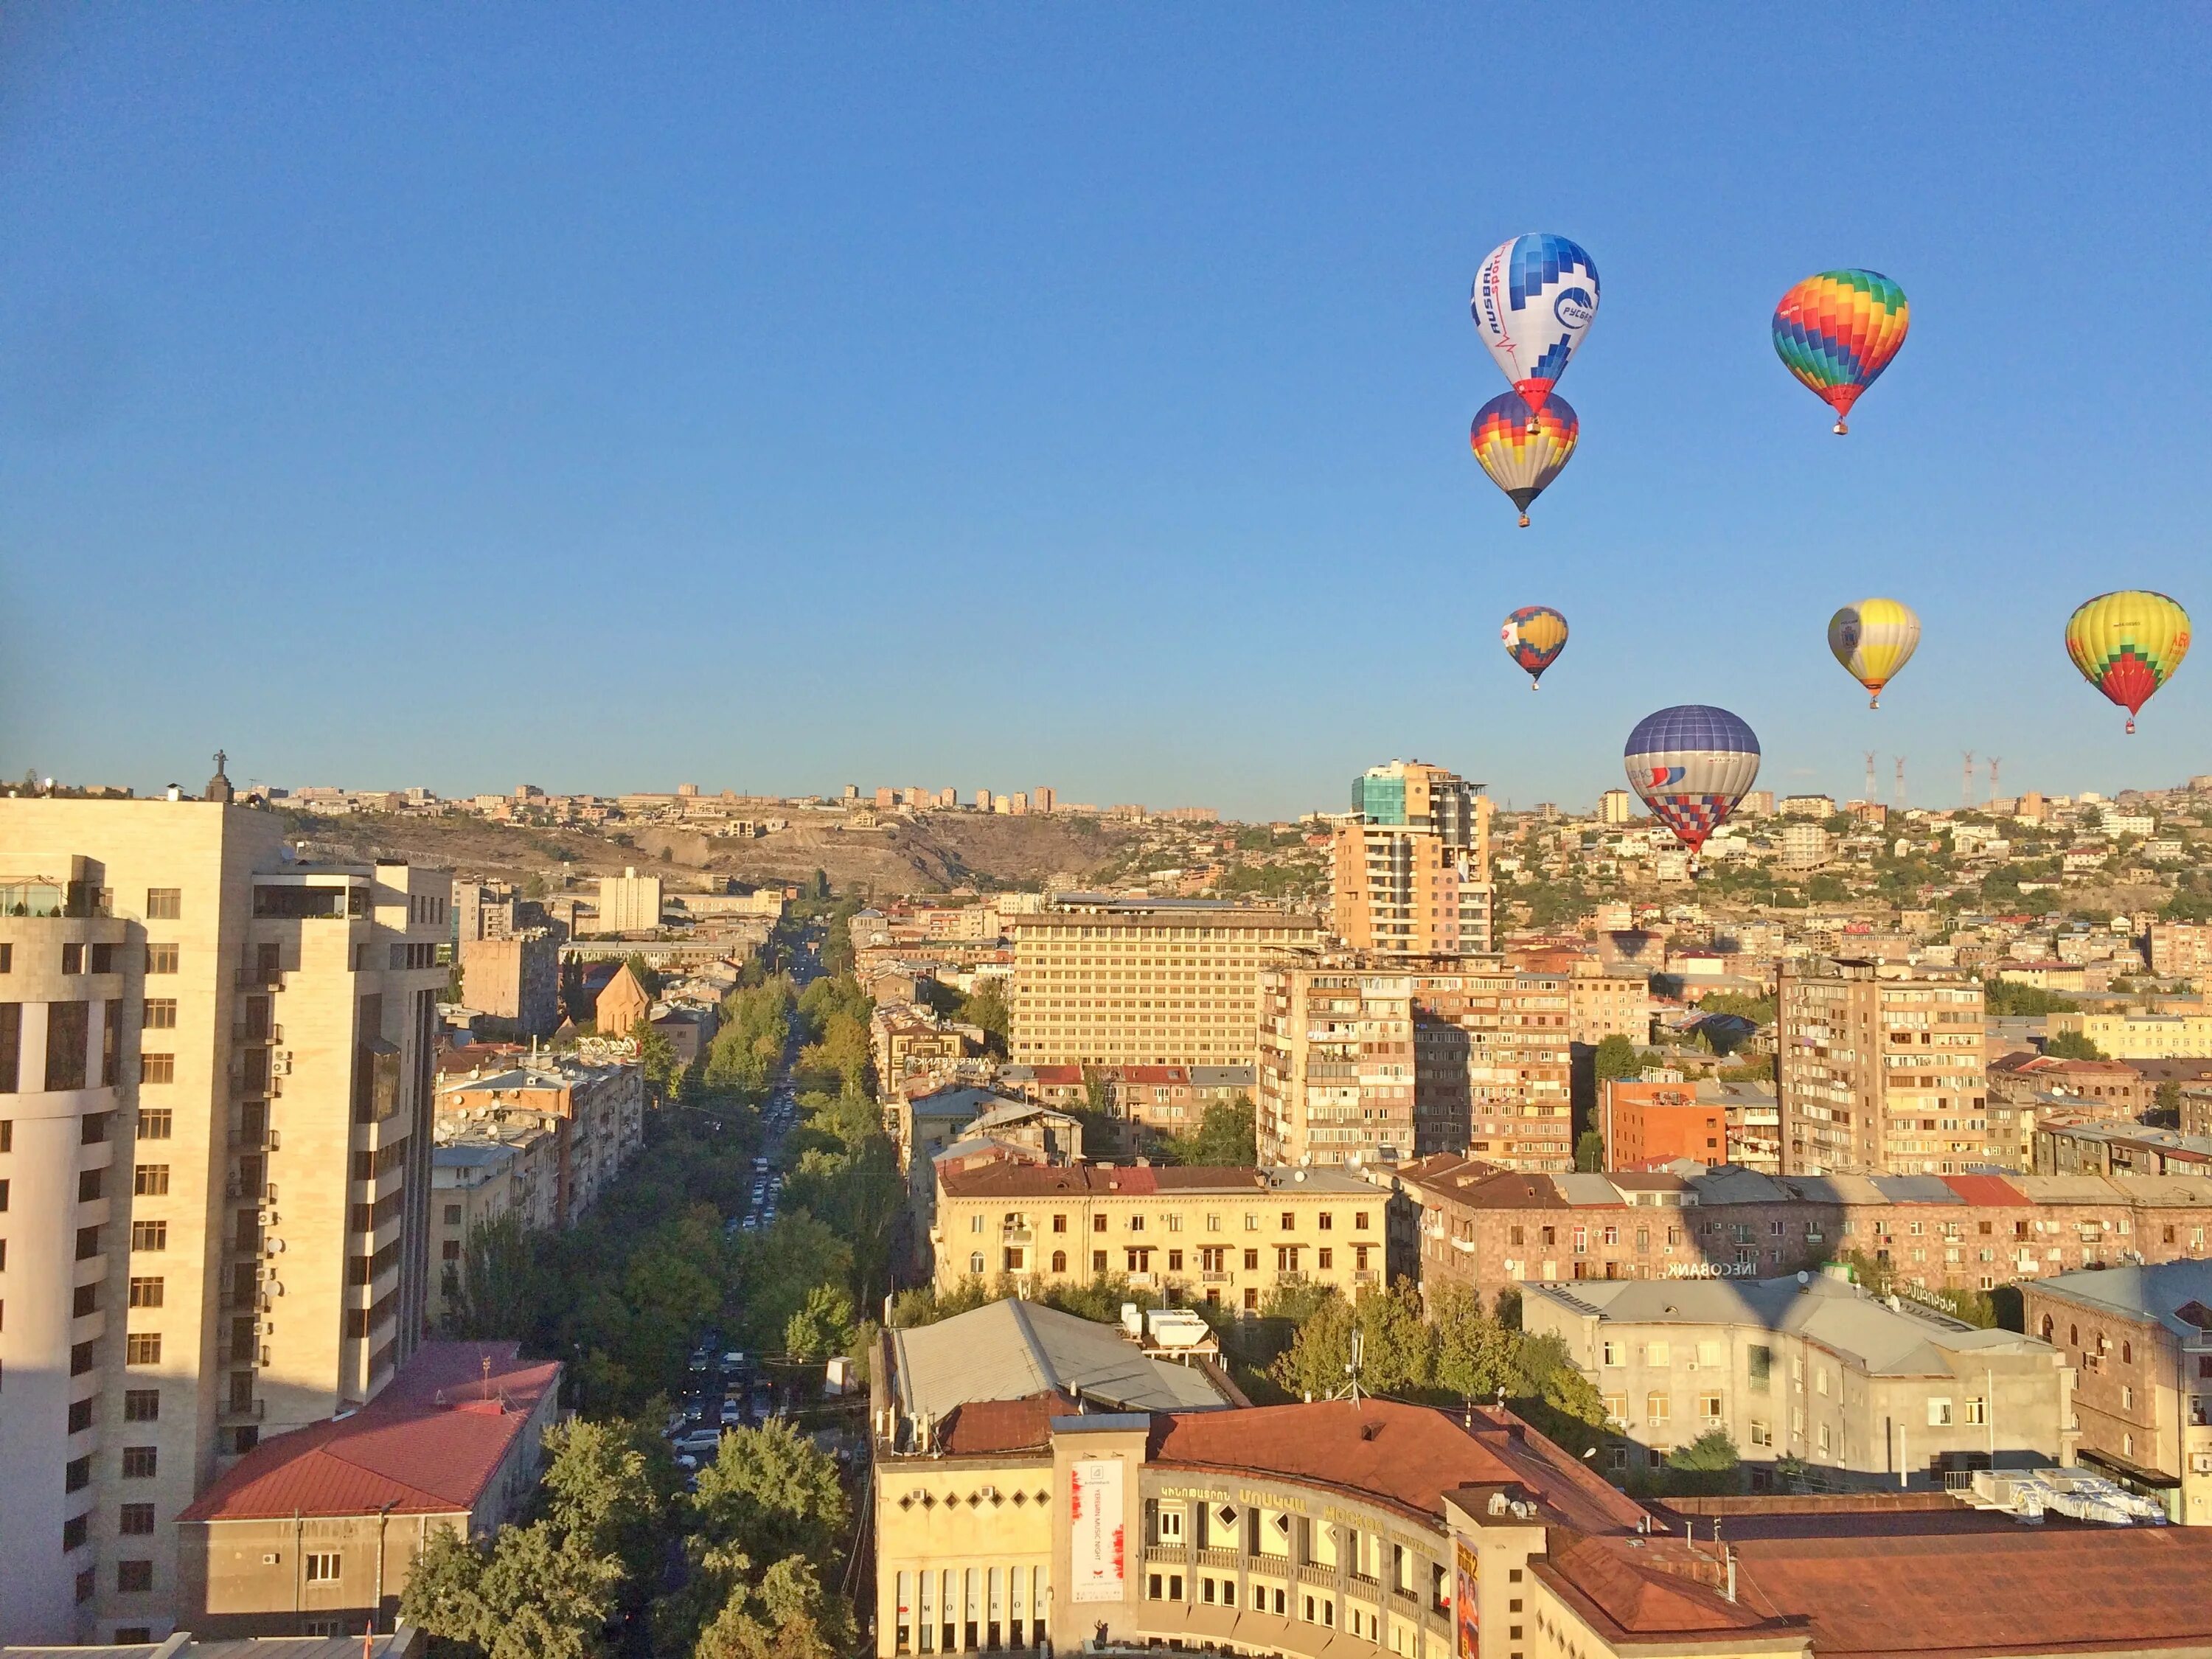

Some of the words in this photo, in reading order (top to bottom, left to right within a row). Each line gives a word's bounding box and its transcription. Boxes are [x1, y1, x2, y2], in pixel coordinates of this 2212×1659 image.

[1483, 262, 1500, 334] RUSBAL
[1161, 1486, 1231, 1501] ԿԻՆՈԹԱՏՐՈՆ
[1239, 1489, 1307, 1513] ՄՈՍԿՎԱ
[1324, 1504, 1385, 1536] МОСКВА
[924, 1600, 1043, 1612] MONROE
